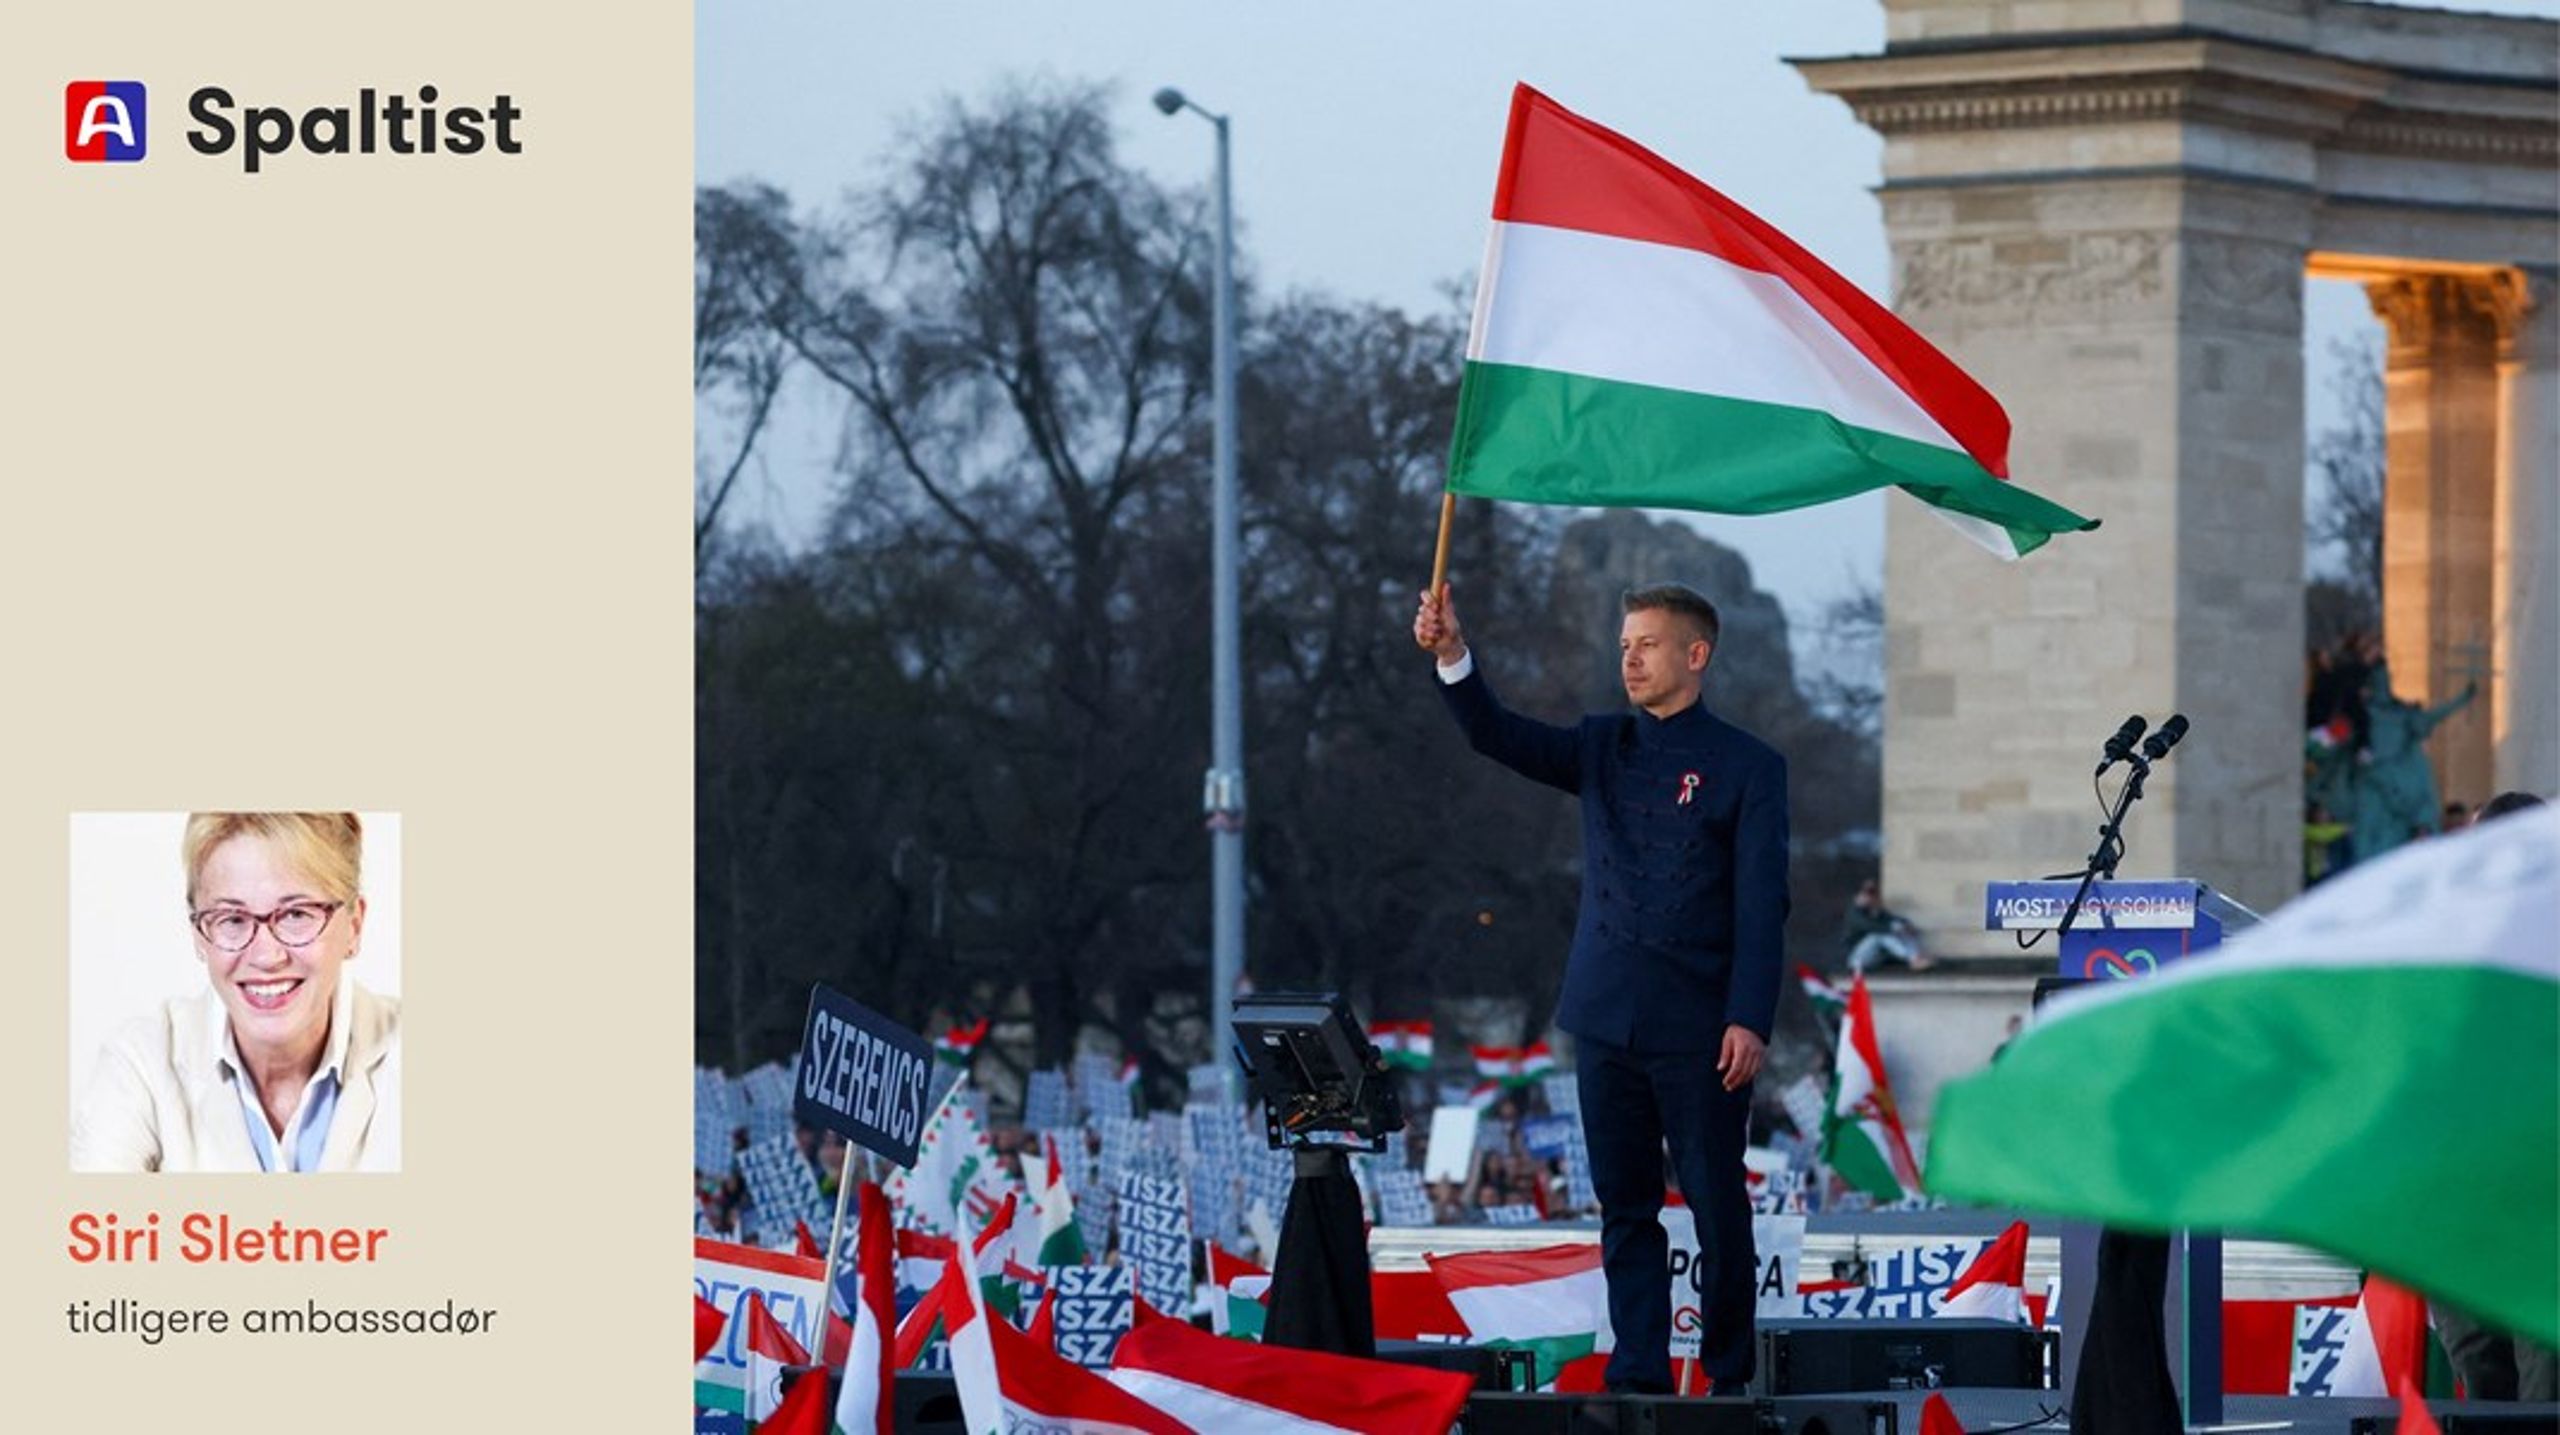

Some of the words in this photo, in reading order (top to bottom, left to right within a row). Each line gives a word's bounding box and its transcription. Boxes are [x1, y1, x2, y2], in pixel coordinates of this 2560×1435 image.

[1995, 897, 2055, 917] MOST
[804, 1009, 925, 1147] SZERENCS
[1118, 1170, 1187, 1209] TISZA
[1119, 1198, 1188, 1238] TISZA
[1119, 1226, 1189, 1265] TISZA
